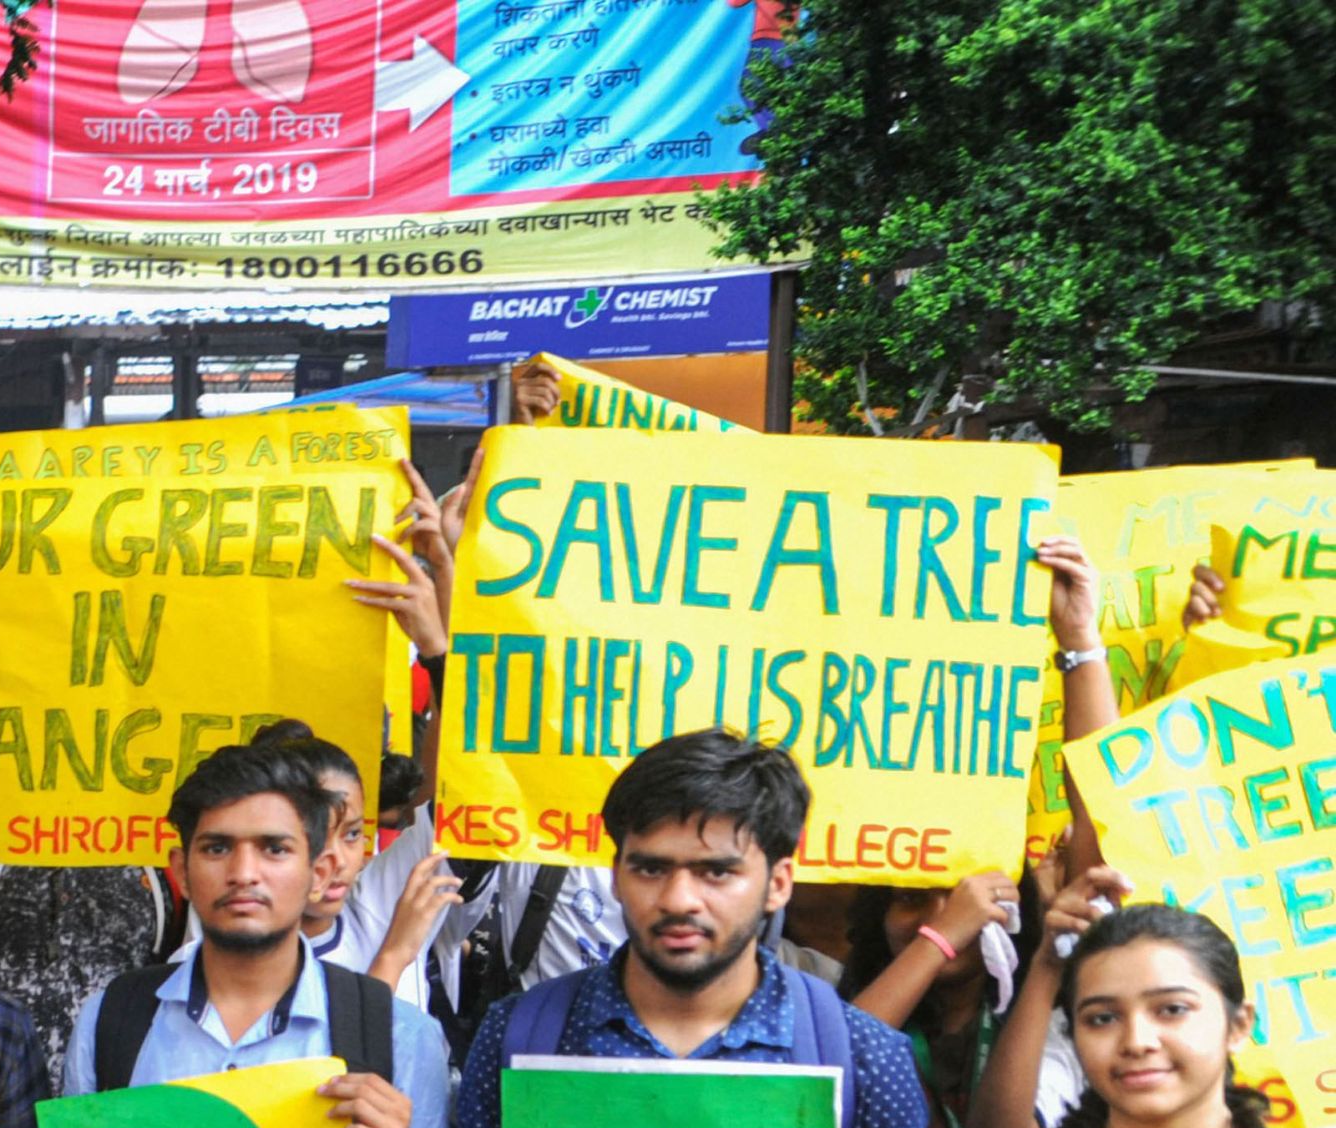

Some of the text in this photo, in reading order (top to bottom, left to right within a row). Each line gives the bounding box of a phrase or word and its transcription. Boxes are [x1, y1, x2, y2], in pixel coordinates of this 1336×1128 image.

[82, 108, 194, 145] जागतिक
[102, 164, 143, 196] 24
[232, 161, 318, 195] 2019
[217, 248, 484, 280] 1800116666
[468, 286, 719, 321] BACHAT CHEMIST
[180, 441, 227, 475] IS
[247, 435, 278, 467] A
[290, 429, 396, 464] FOREST
[90, 486, 379, 581] GREEN
[475, 477, 1052, 627] SAVE A TREE
[69, 588, 168, 690] IN
[451, 633, 545, 754] TO
[559, 635, 696, 758] HELP
[813, 650, 1040, 780] BREATHE
[434, 802, 522, 848] KES
